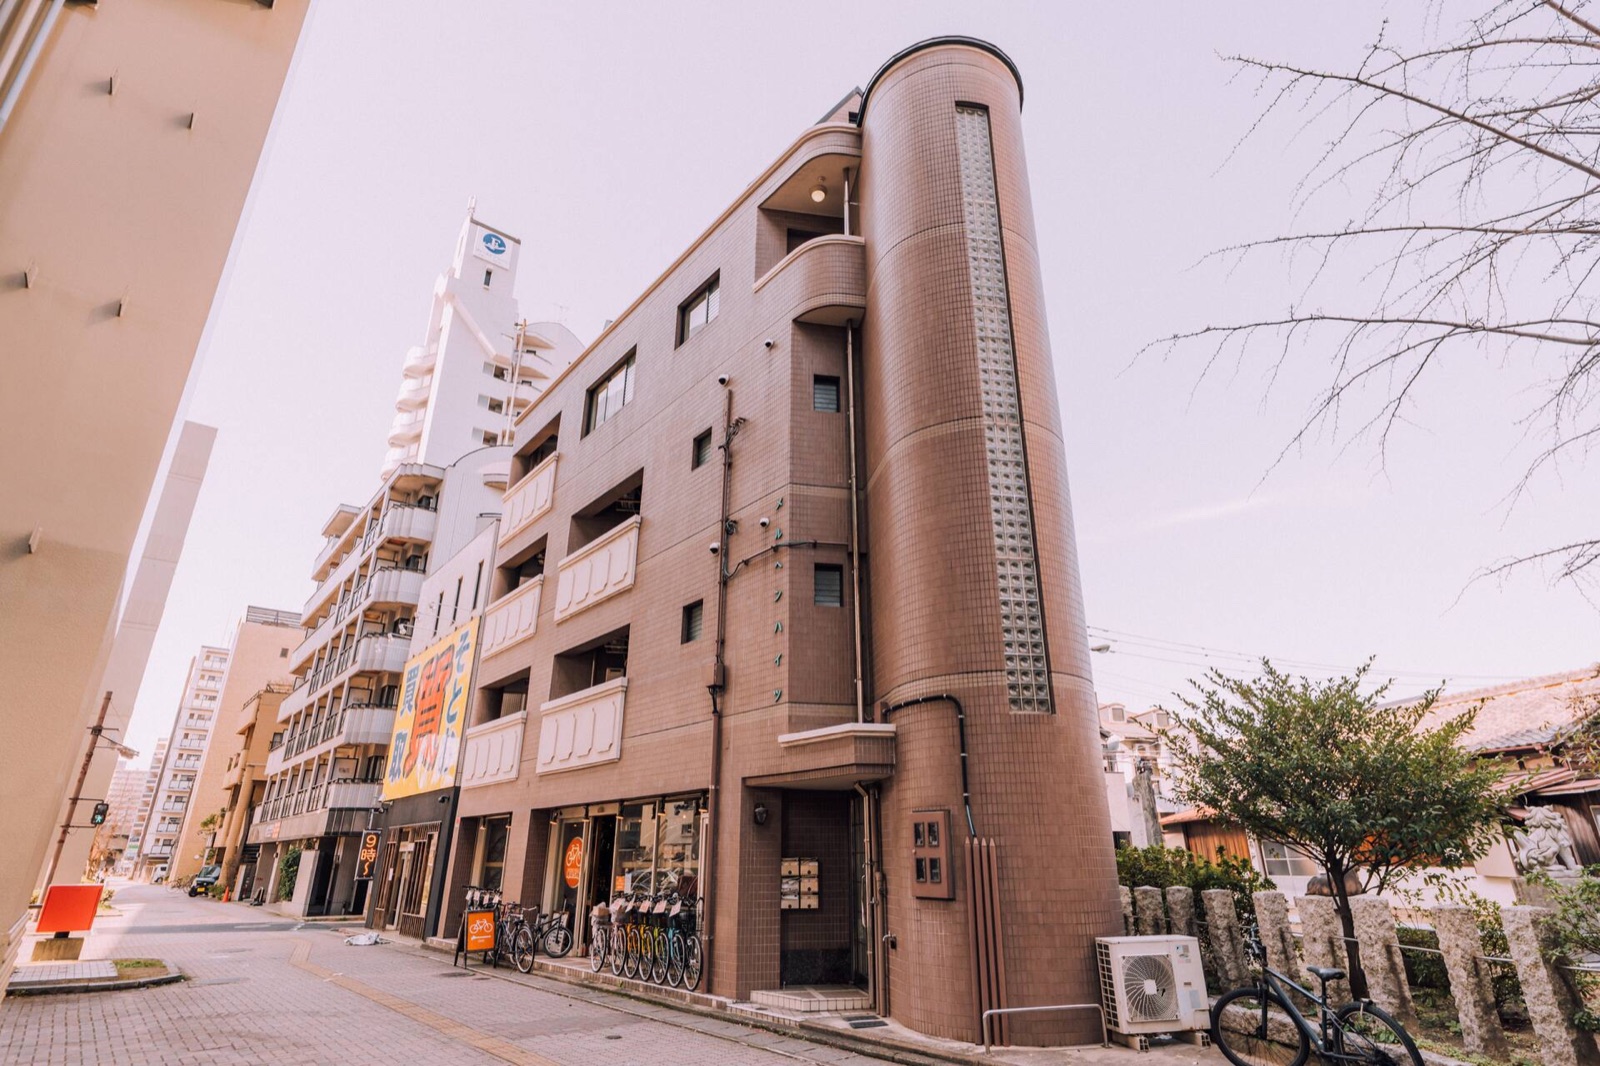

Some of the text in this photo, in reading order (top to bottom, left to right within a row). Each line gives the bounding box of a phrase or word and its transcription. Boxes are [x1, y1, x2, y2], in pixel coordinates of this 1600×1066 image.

[774, 497, 784, 703] メルヘンハイツ
[389, 664, 420, 783] 買取
